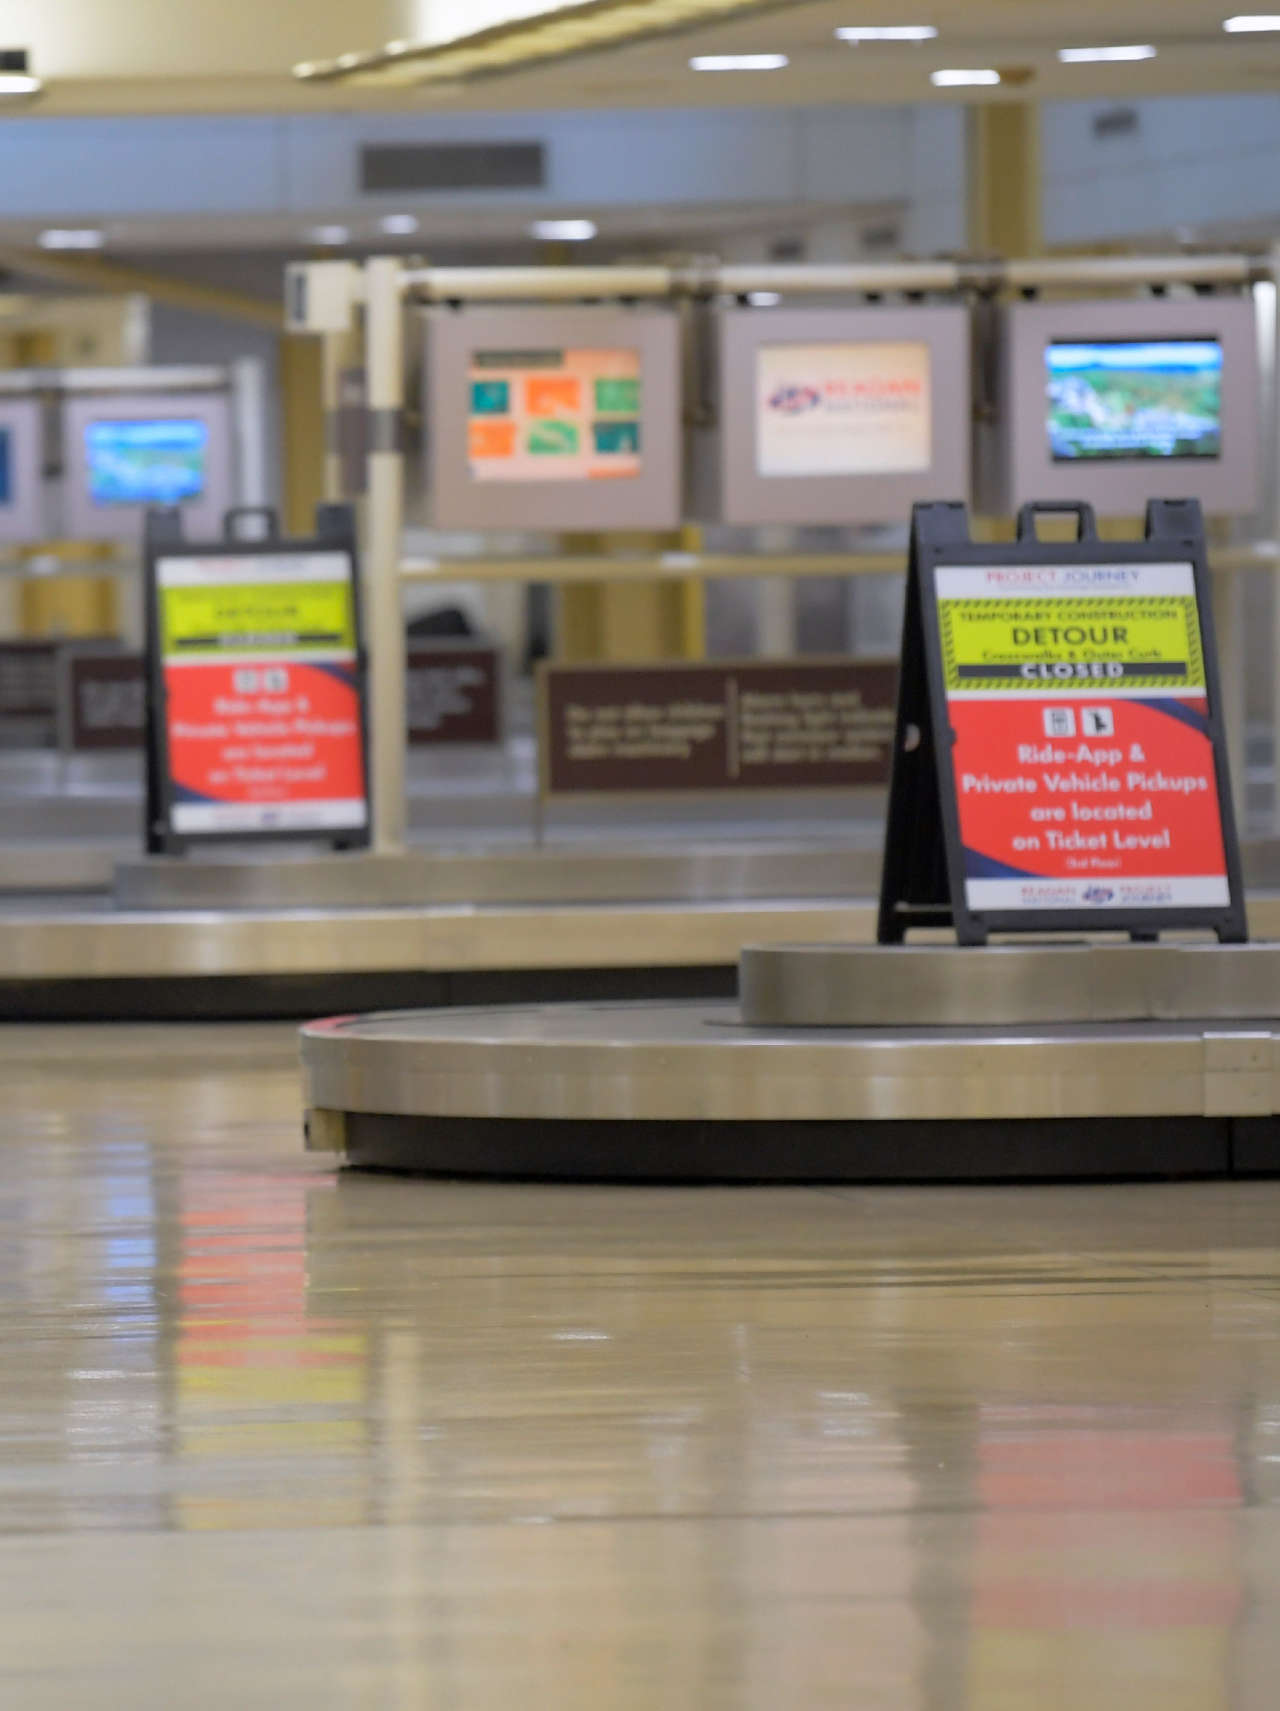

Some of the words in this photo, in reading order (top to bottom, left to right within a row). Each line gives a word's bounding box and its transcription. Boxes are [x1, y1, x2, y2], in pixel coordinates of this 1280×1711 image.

[985, 571, 1057, 583] PROJECT
[1064, 570, 1140, 582] JOURNEY
[960, 610, 1053, 622] TEMPORARY
[1057, 609, 1178, 621] CONSTRUCTION
[1012, 626, 1129, 646] DETOUR
[1020, 662, 1124, 680] CLOSED
[1017, 743, 1123, 766] Ride-App
[1129, 743, 1146, 763] &
[962, 773, 1038, 793] Private
[1043, 772, 1121, 793] Vehicle
[1126, 772, 1208, 795] Pickups
[1030, 806, 1066, 822] are
[1071, 800, 1153, 821] located
[1012, 835, 1040, 851] on
[1044, 829, 1108, 851] Ticket
[1113, 828, 1170, 850] Level
